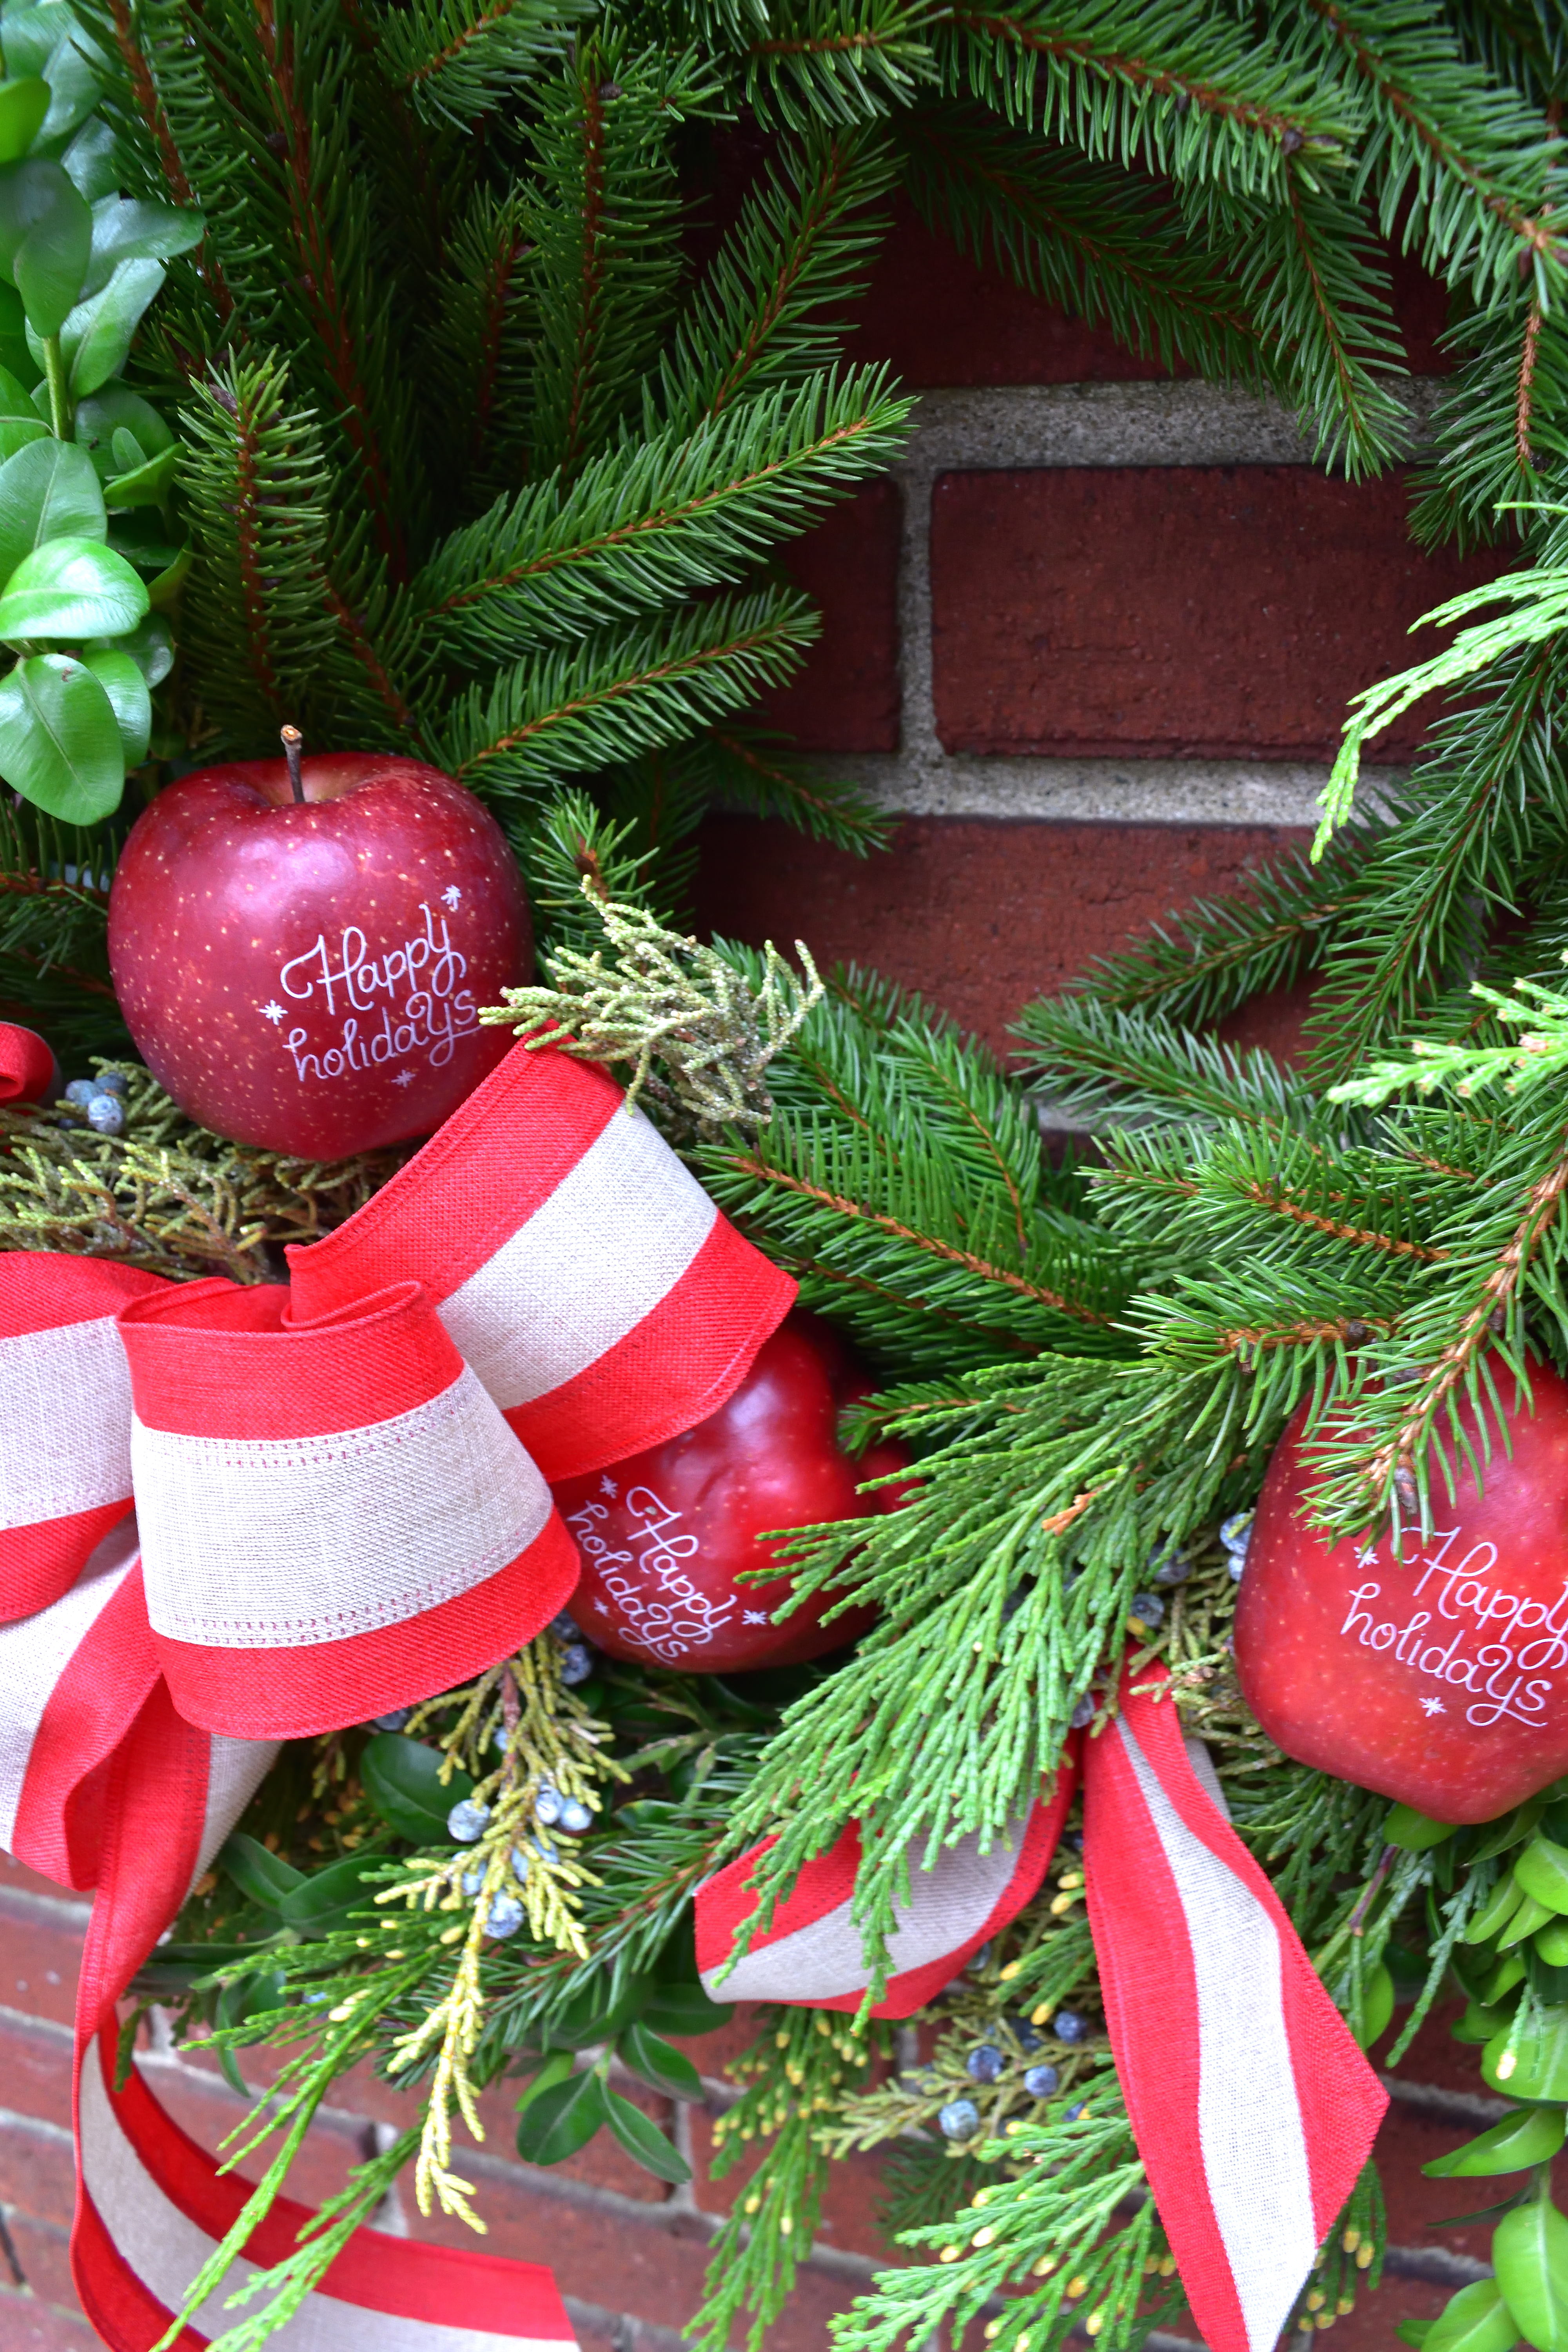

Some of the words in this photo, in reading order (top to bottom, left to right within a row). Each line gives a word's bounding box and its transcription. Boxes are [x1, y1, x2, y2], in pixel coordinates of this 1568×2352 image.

[280, 903, 466, 1011] Happy
[282, 989, 484, 1082] holidays
[567, 1500, 689, 1665] holidays
[626, 1486, 737, 1644] Happy
[1390, 1526, 1568, 1670] Happy
[1340, 1582, 1553, 1727] holidays
